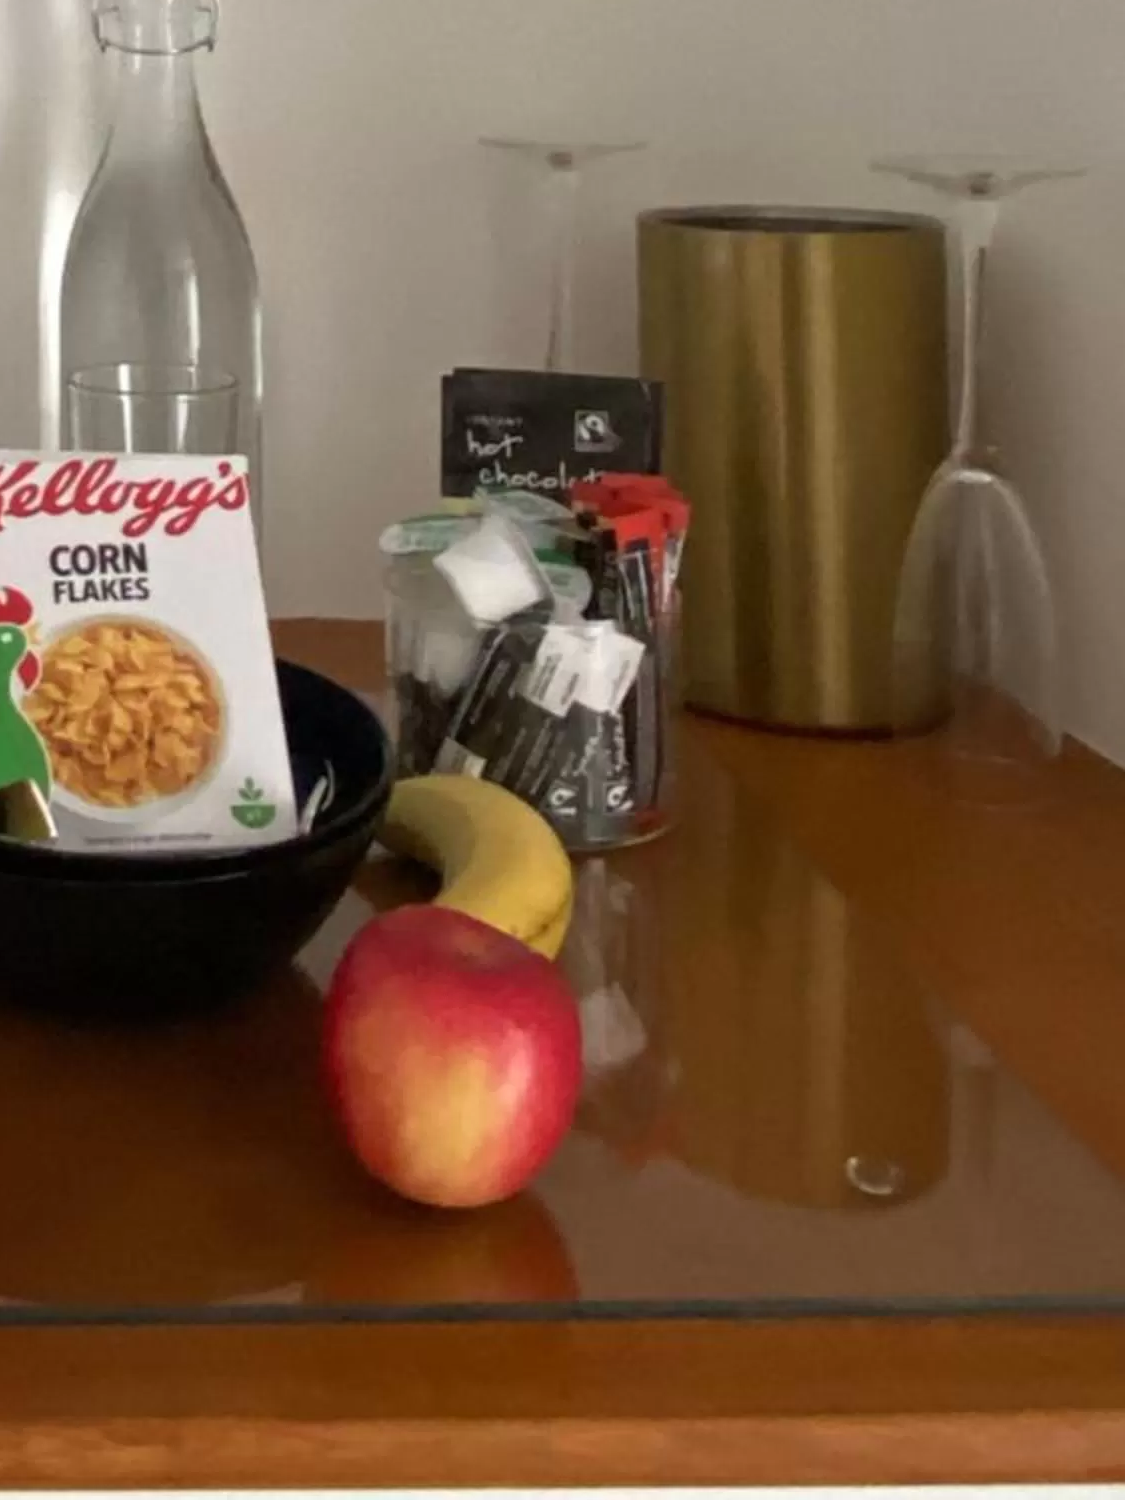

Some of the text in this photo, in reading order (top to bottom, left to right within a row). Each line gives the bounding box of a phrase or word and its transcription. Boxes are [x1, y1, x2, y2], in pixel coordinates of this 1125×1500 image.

[466, 428, 524, 458] hot
[478, 459, 606, 490] chocolt
[49, 543, 148, 576] CORN
[53, 577, 150, 604] FLAKES
